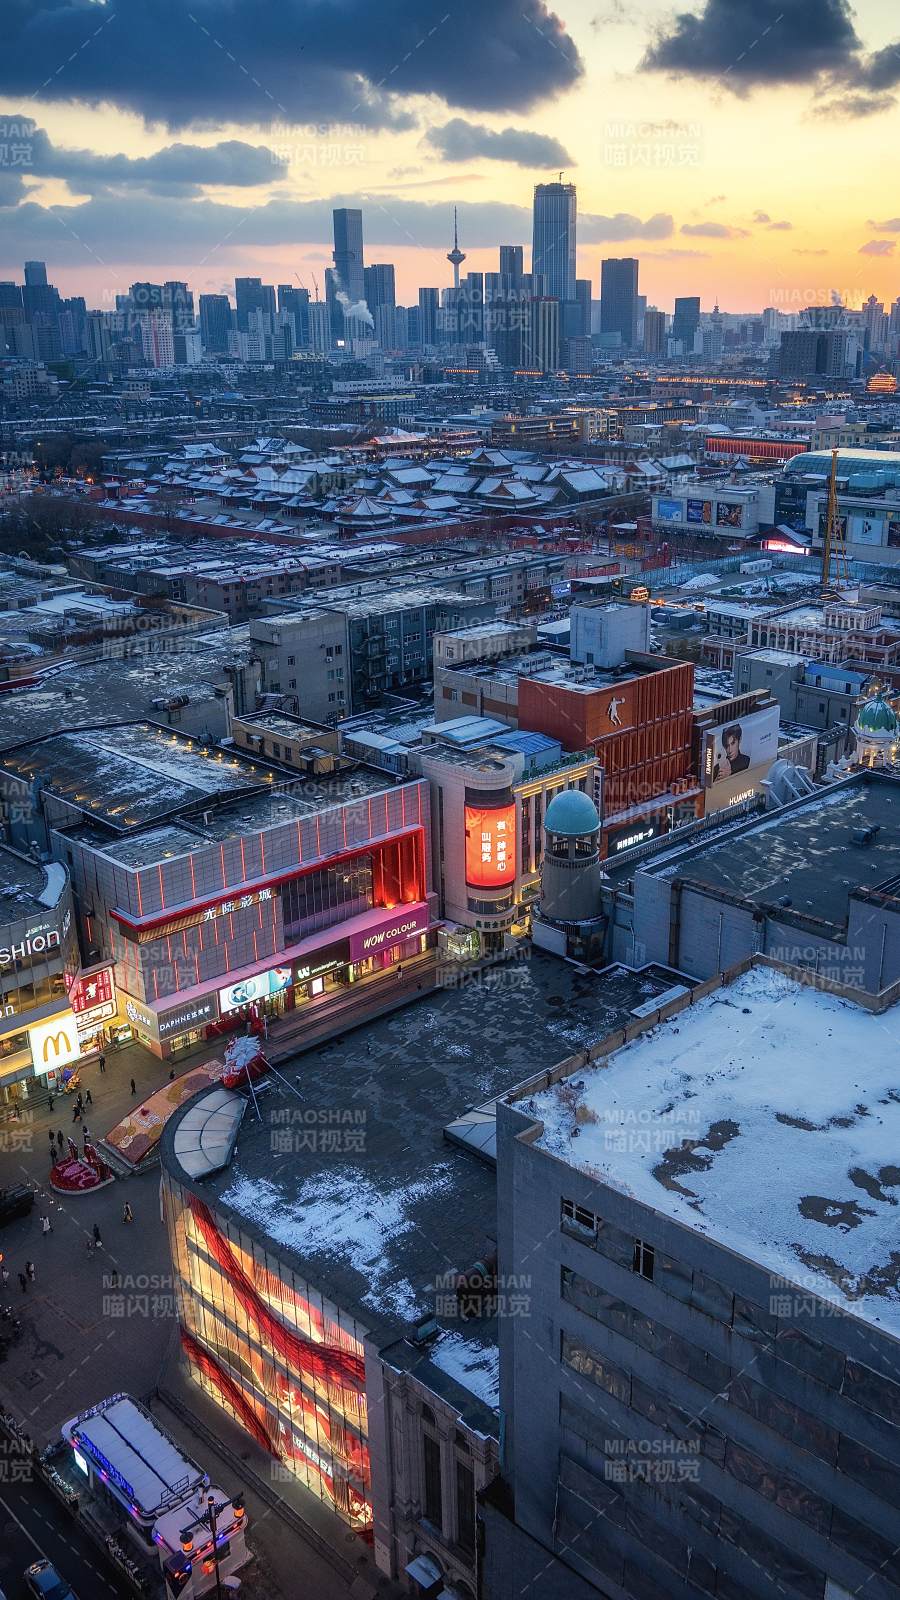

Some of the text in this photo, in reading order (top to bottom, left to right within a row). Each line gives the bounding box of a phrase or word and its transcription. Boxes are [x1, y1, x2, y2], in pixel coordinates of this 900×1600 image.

[729, 788, 754, 806] HUAWEI
[363, 931, 385, 949] WOW
[385, 920, 417, 939] COLOUR
